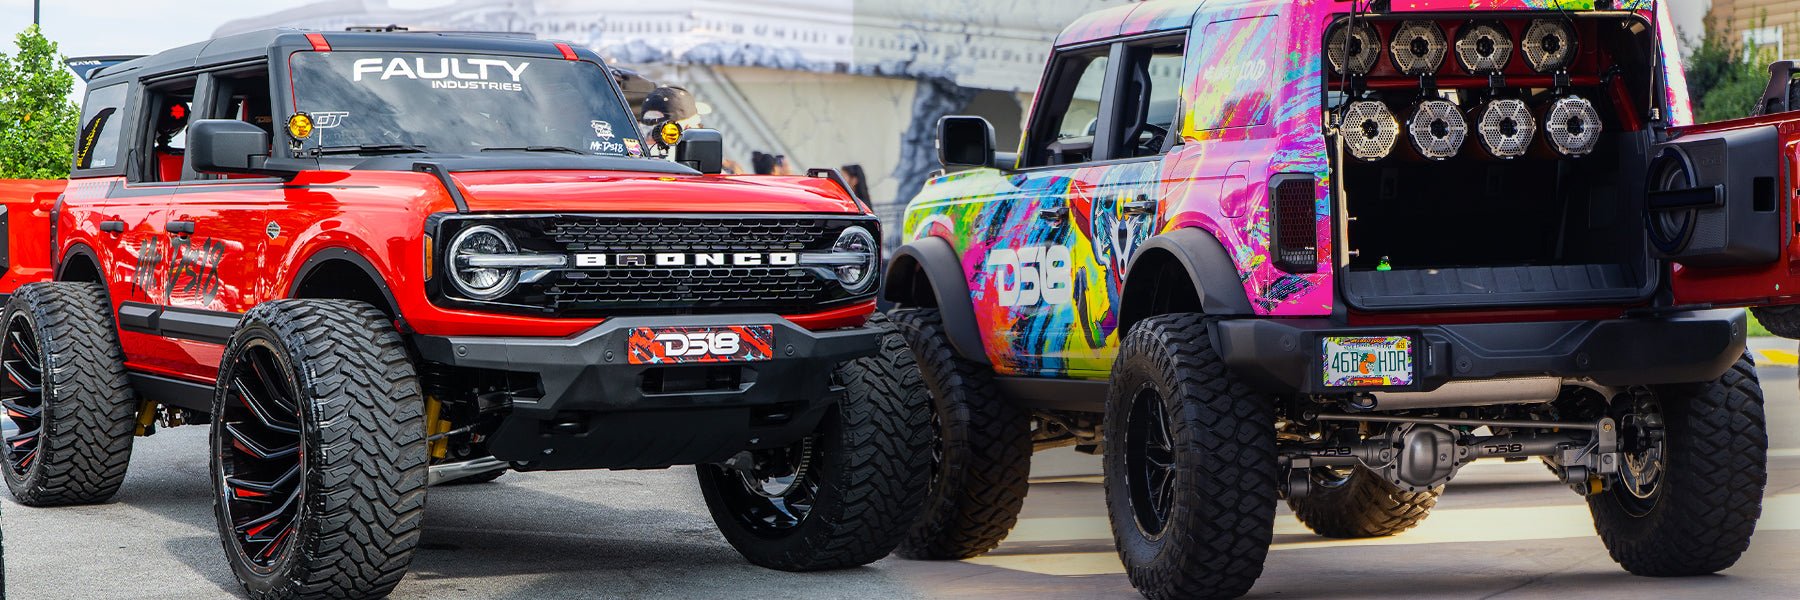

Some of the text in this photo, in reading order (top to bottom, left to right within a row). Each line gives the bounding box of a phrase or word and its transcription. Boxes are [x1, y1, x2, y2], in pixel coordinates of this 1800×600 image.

[353, 57, 530, 82] FAULTY
[432, 80, 523, 92] INDUSTRIES
[575, 253, 797, 267] BRONCO
[987, 244, 1072, 307] DS18
[655, 332, 741, 357] DS18
[1331, 350, 1407, 373] 46B HDR
[1484, 444, 1523, 454] DS18
